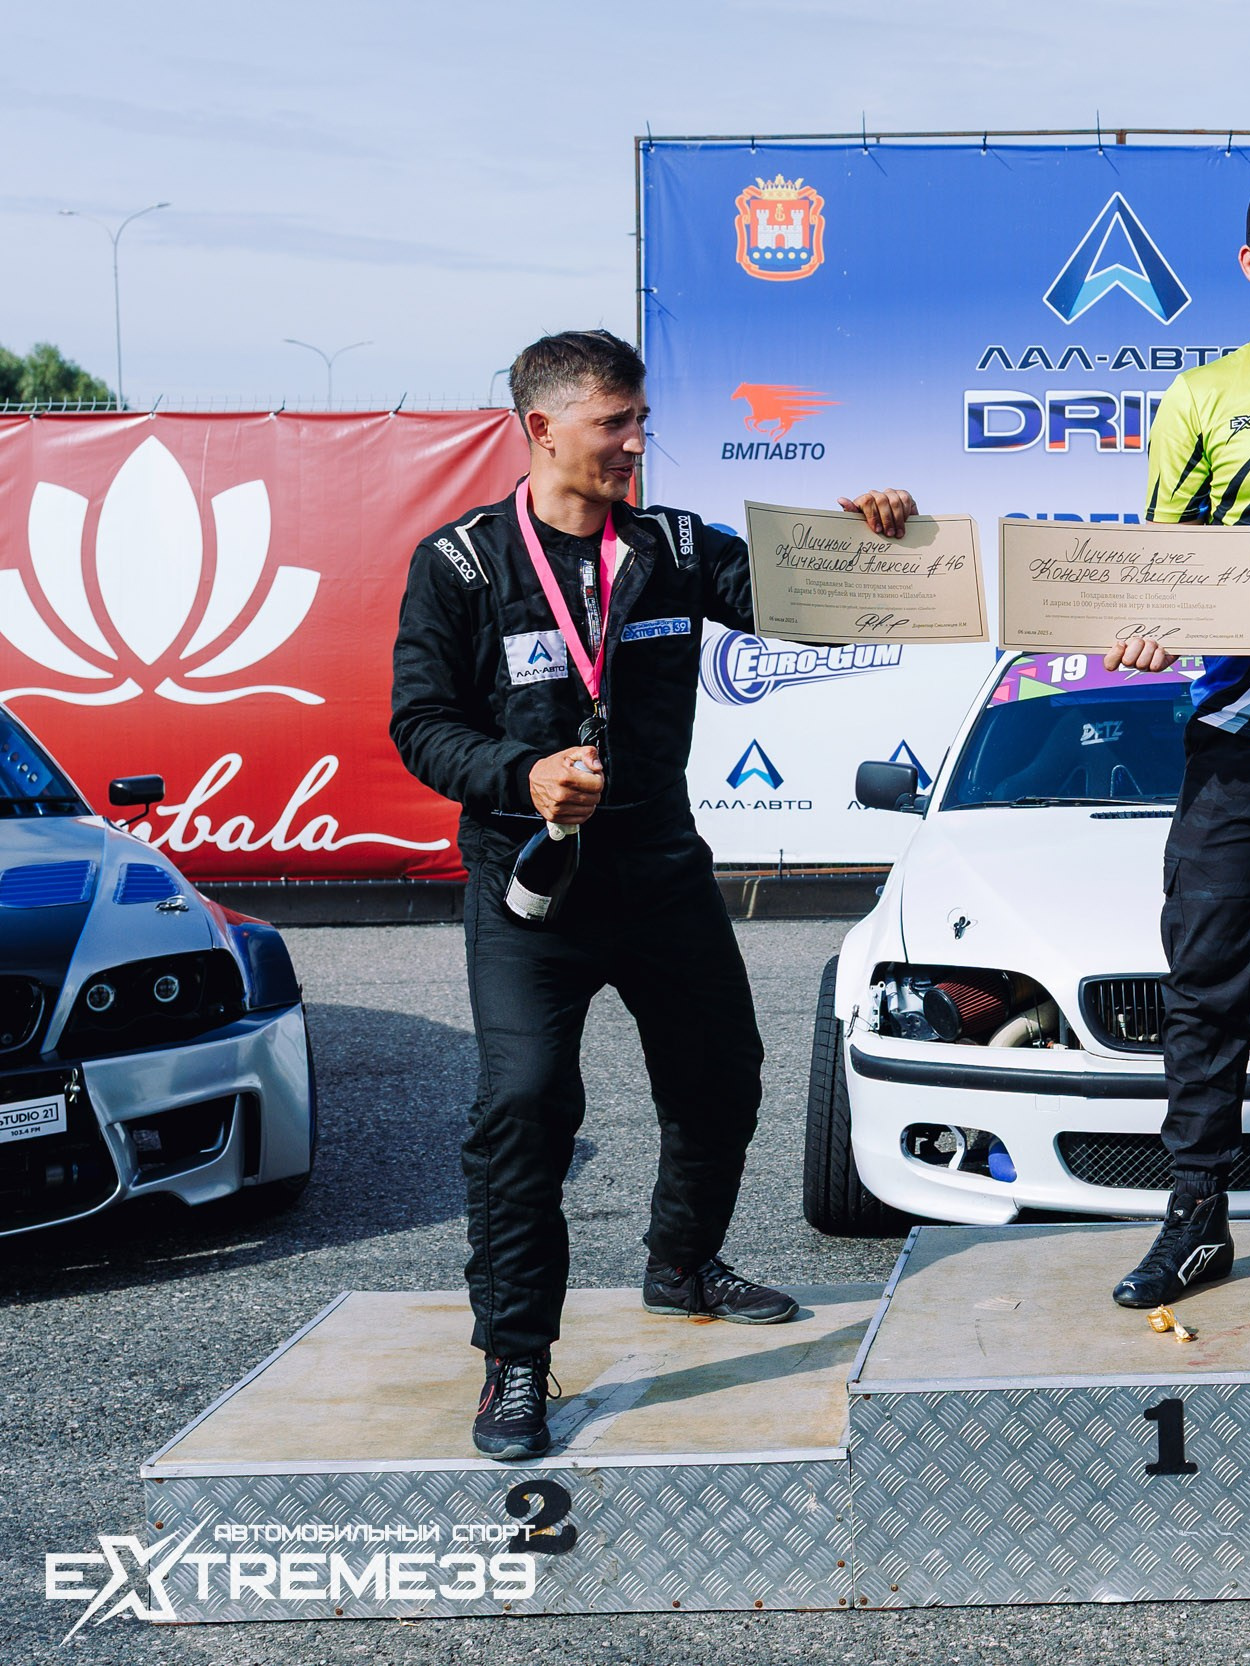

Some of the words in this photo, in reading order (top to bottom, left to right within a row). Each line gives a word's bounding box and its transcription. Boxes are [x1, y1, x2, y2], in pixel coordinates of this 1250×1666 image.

[976, 345, 1243, 372] ЛАЛ-АВТ
[964, 390, 1158, 452] DRI
[721, 442, 825, 461] ВМПАВТО
[674, 621, 687, 632] 39
[1048, 654, 1088, 683] 19
[43, 1108, 54, 1119] 21
[1144, 1399, 1198, 1475] 1
[505, 1480, 576, 1555] 2
